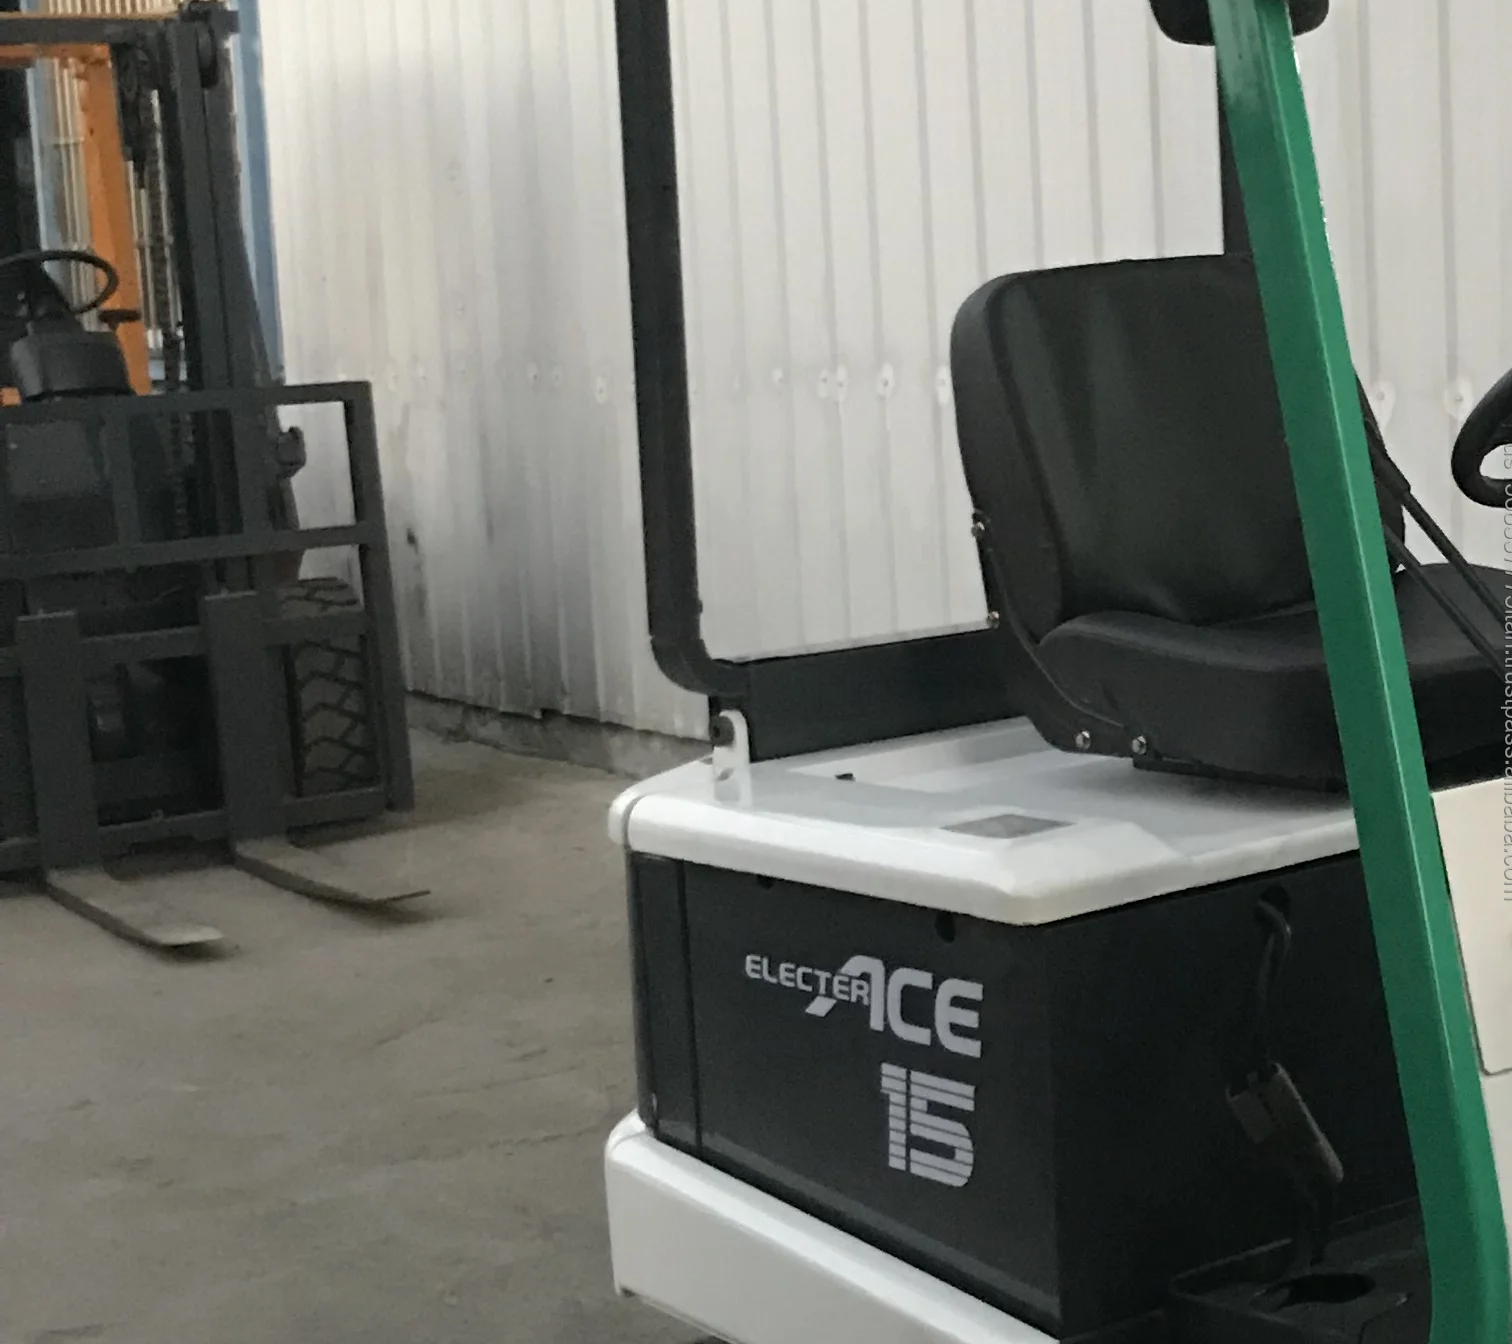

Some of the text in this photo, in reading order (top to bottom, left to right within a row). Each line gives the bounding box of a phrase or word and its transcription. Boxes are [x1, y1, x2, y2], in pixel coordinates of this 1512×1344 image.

[744, 954, 984, 1058] ELECTER ACE
[880, 1062, 976, 1187] 15
